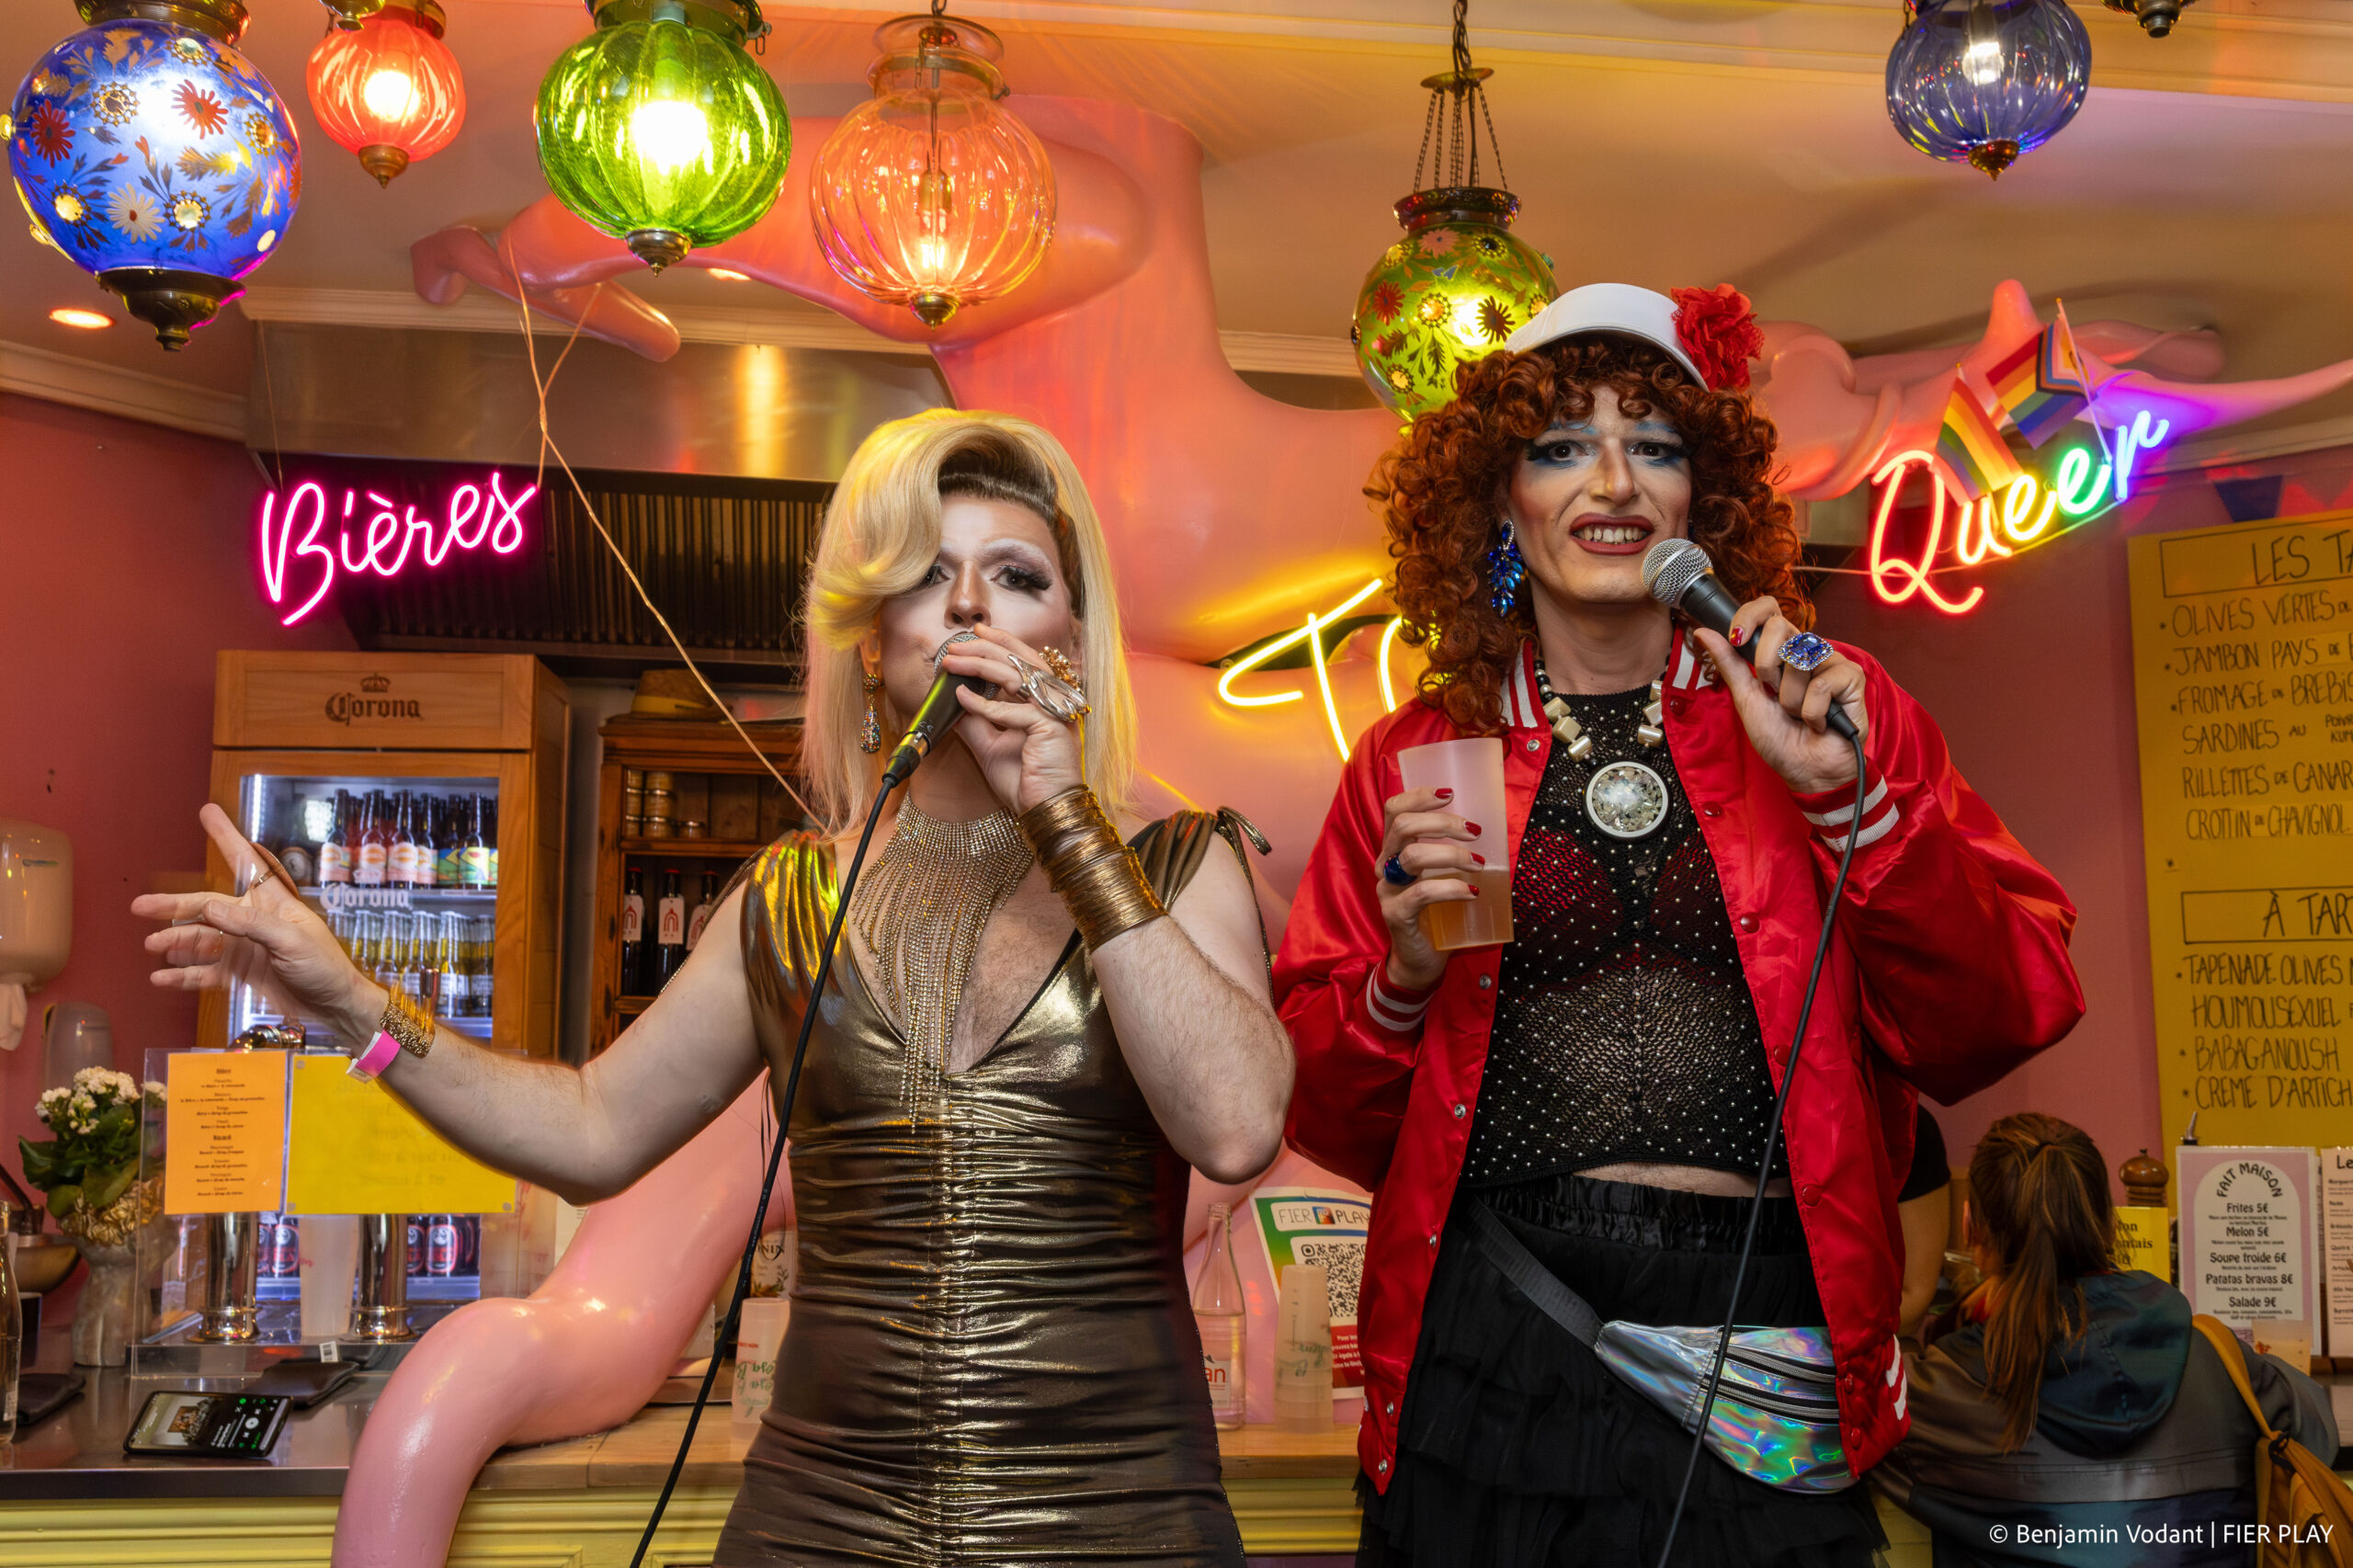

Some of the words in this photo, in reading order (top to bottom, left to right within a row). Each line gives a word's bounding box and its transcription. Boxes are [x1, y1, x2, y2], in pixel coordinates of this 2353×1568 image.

[1870, 410, 2169, 615] Queer
[261, 471, 538, 626] Bières
[2252, 535, 2310, 585] LES
[2172, 597, 2255, 638] OLIVES
[2262, 589, 2336, 625] VERTES
[2172, 642, 2260, 676] JAMBON
[2271, 638, 2319, 670] PAYS
[324, 692, 425, 727] Corona
[2177, 679, 2268, 715] FROMAGE
[2182, 719, 2280, 755] SARDINES
[2289, 724, 2307, 737] AU
[2186, 808, 2252, 840] CROTTIN
[2268, 803, 2352, 837] CHAVIGNOL
[320, 882, 414, 913] Corona
[2262, 890, 2286, 937] À
[2182, 952, 2278, 985] TAPENADE
[2280, 954, 2344, 986] OLIVES
[2191, 994, 2342, 1029] HOUMOUSEXUEL
[2195, 1034, 2340, 1072] BABAGANOUSH
[2195, 1074, 2257, 1110] CREME
[2216, 1167, 2237, 1199] FAIT
[2239, 1162, 2283, 1198] MAISON
[1279, 1209, 1313, 1225] FIER
[1335, 1210, 1370, 1225] PLAY
[2227, 1202, 2254, 1213] Frites
[2256, 1202, 2268, 1213] 5€
[2226, 1226, 2255, 1237] Melon
[2257, 1226, 2269, 1237] 5€
[2210, 1252, 2240, 1263] Soupe
[2243, 1252, 2271, 1263] froide
[2274, 1252, 2287, 1263] 6€
[2206, 1274, 2243, 1285] Patatas
[2245, 1273, 2279, 1285] bravas
[2280, 1274, 2293, 1285] 8€
[2229, 1296, 2261, 1307] Salade
[2264, 1297, 2277, 1307] 9€
